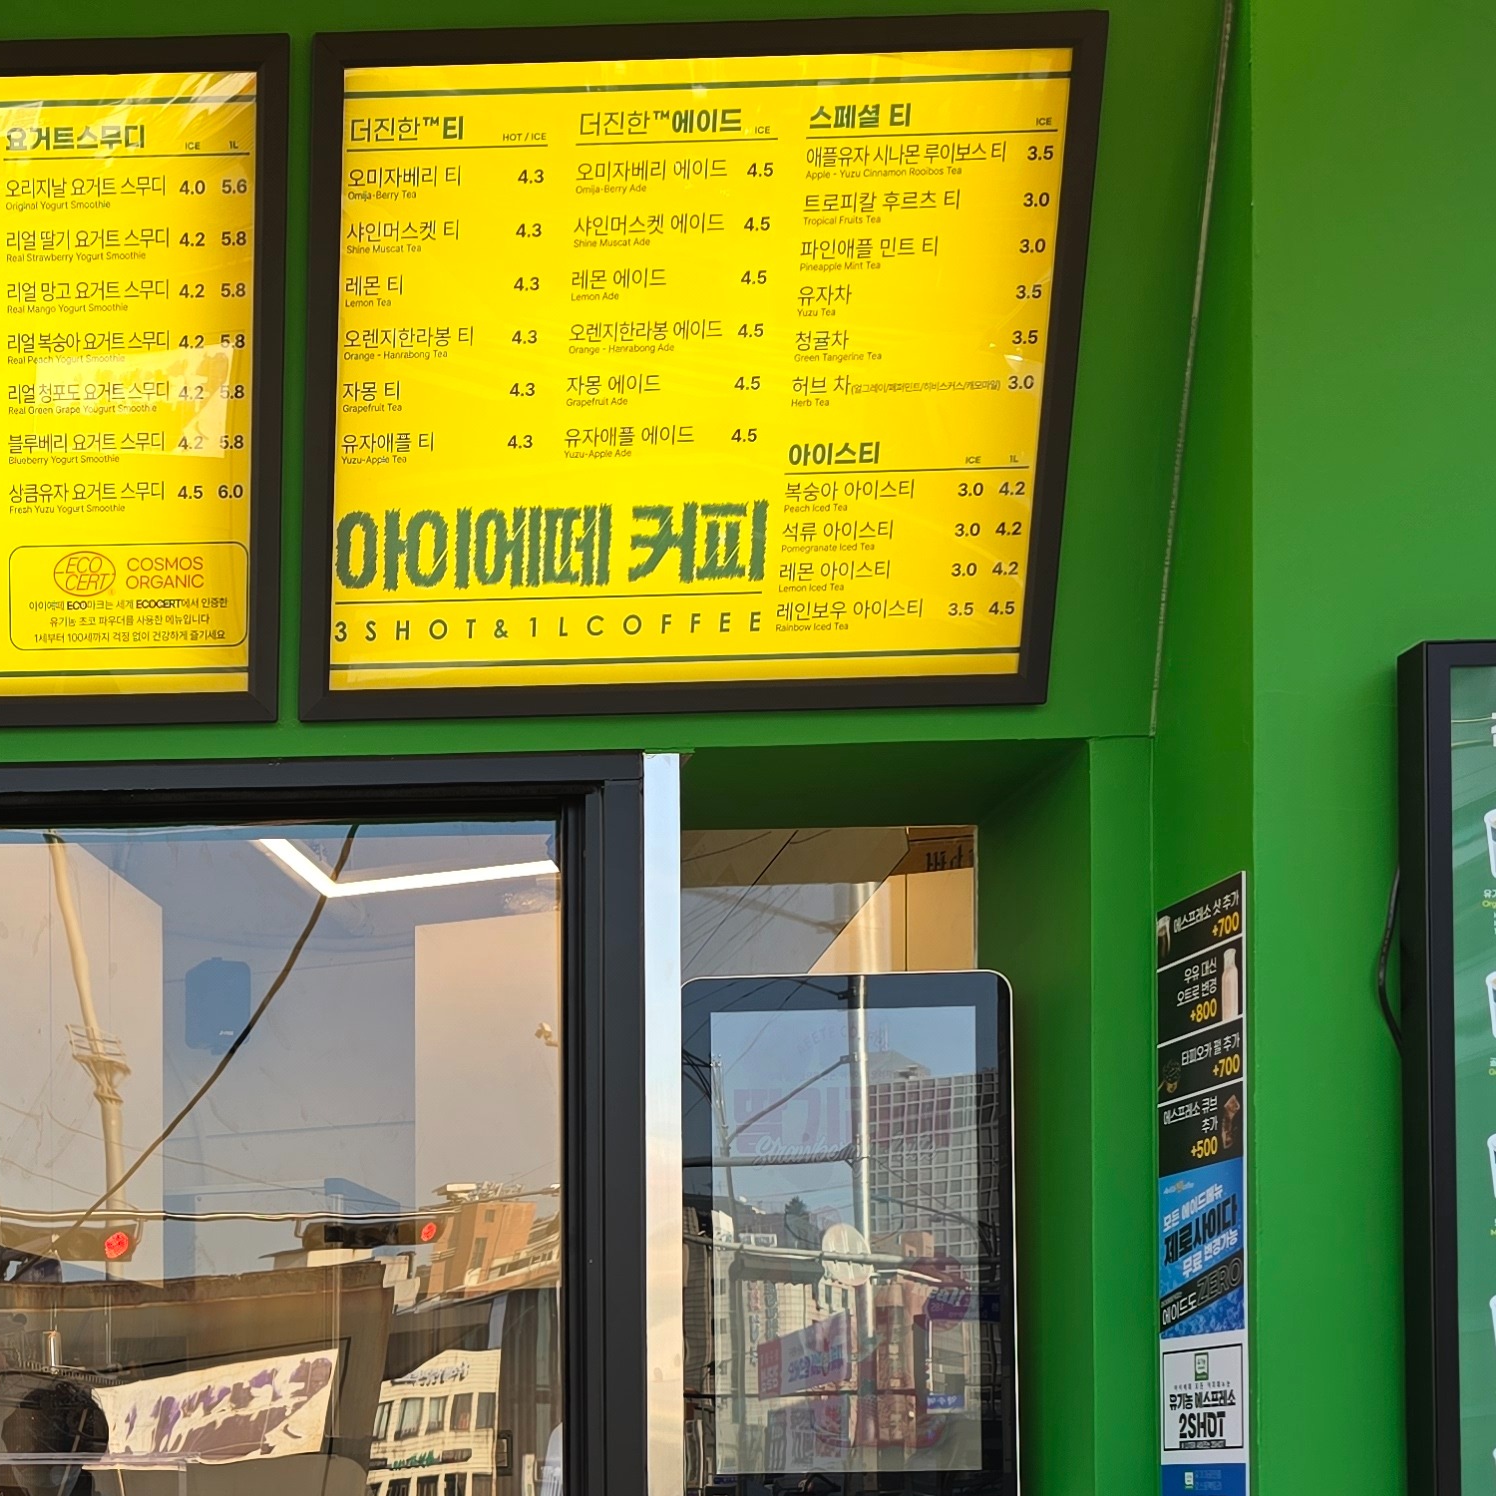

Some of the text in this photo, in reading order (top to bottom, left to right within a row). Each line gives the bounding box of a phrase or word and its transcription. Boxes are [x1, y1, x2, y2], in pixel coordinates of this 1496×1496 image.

[810, 103, 1052, 129] 스페셜 티 ICE
[6, 125, 144, 150] 요거트스무디
[6, 178, 67, 198] 오리지날
[180, 180, 205, 194] 4.0
[222, 180, 247, 193] 5.6
[6, 200, 110, 211] Original Yogurt Smoothie
[347, 220, 542, 241] 샤인머스켓 티 4.3
[347, 244, 422, 254] Shine Muscat Tea
[572, 268, 767, 289] 레몬 에이드 4.5
[798, 284, 1042, 306] 유자차 3.5
[794, 352, 882, 362] Green Tangerine Tea
[788, 442, 880, 466] 아이스티
[785, 479, 1026, 502] 복숭아 아이스티 3.0 4.2
[336, 500, 769, 591] 아이에떼 커피
[66, 556, 102, 573] ECO
[127, 557, 203, 571] COSMOS
[65, 573, 109, 590] CERT
[126, 575, 204, 590] ORGANIC
[1223, 889, 1239, 911] 추가
[1212, 912, 1239, 938] +700
[1183, 957, 1217, 984] 우유 대신
[1176, 977, 1217, 1007] 오트로 변경
[1190, 998, 1217, 1023] +800
[1191, 1136, 1218, 1160] +500
[1163, 1208, 1180, 1232] 모든
[1196, 1258, 1242, 1306] ZERO
[1179, 1411, 1225, 1438] 2SHOT
